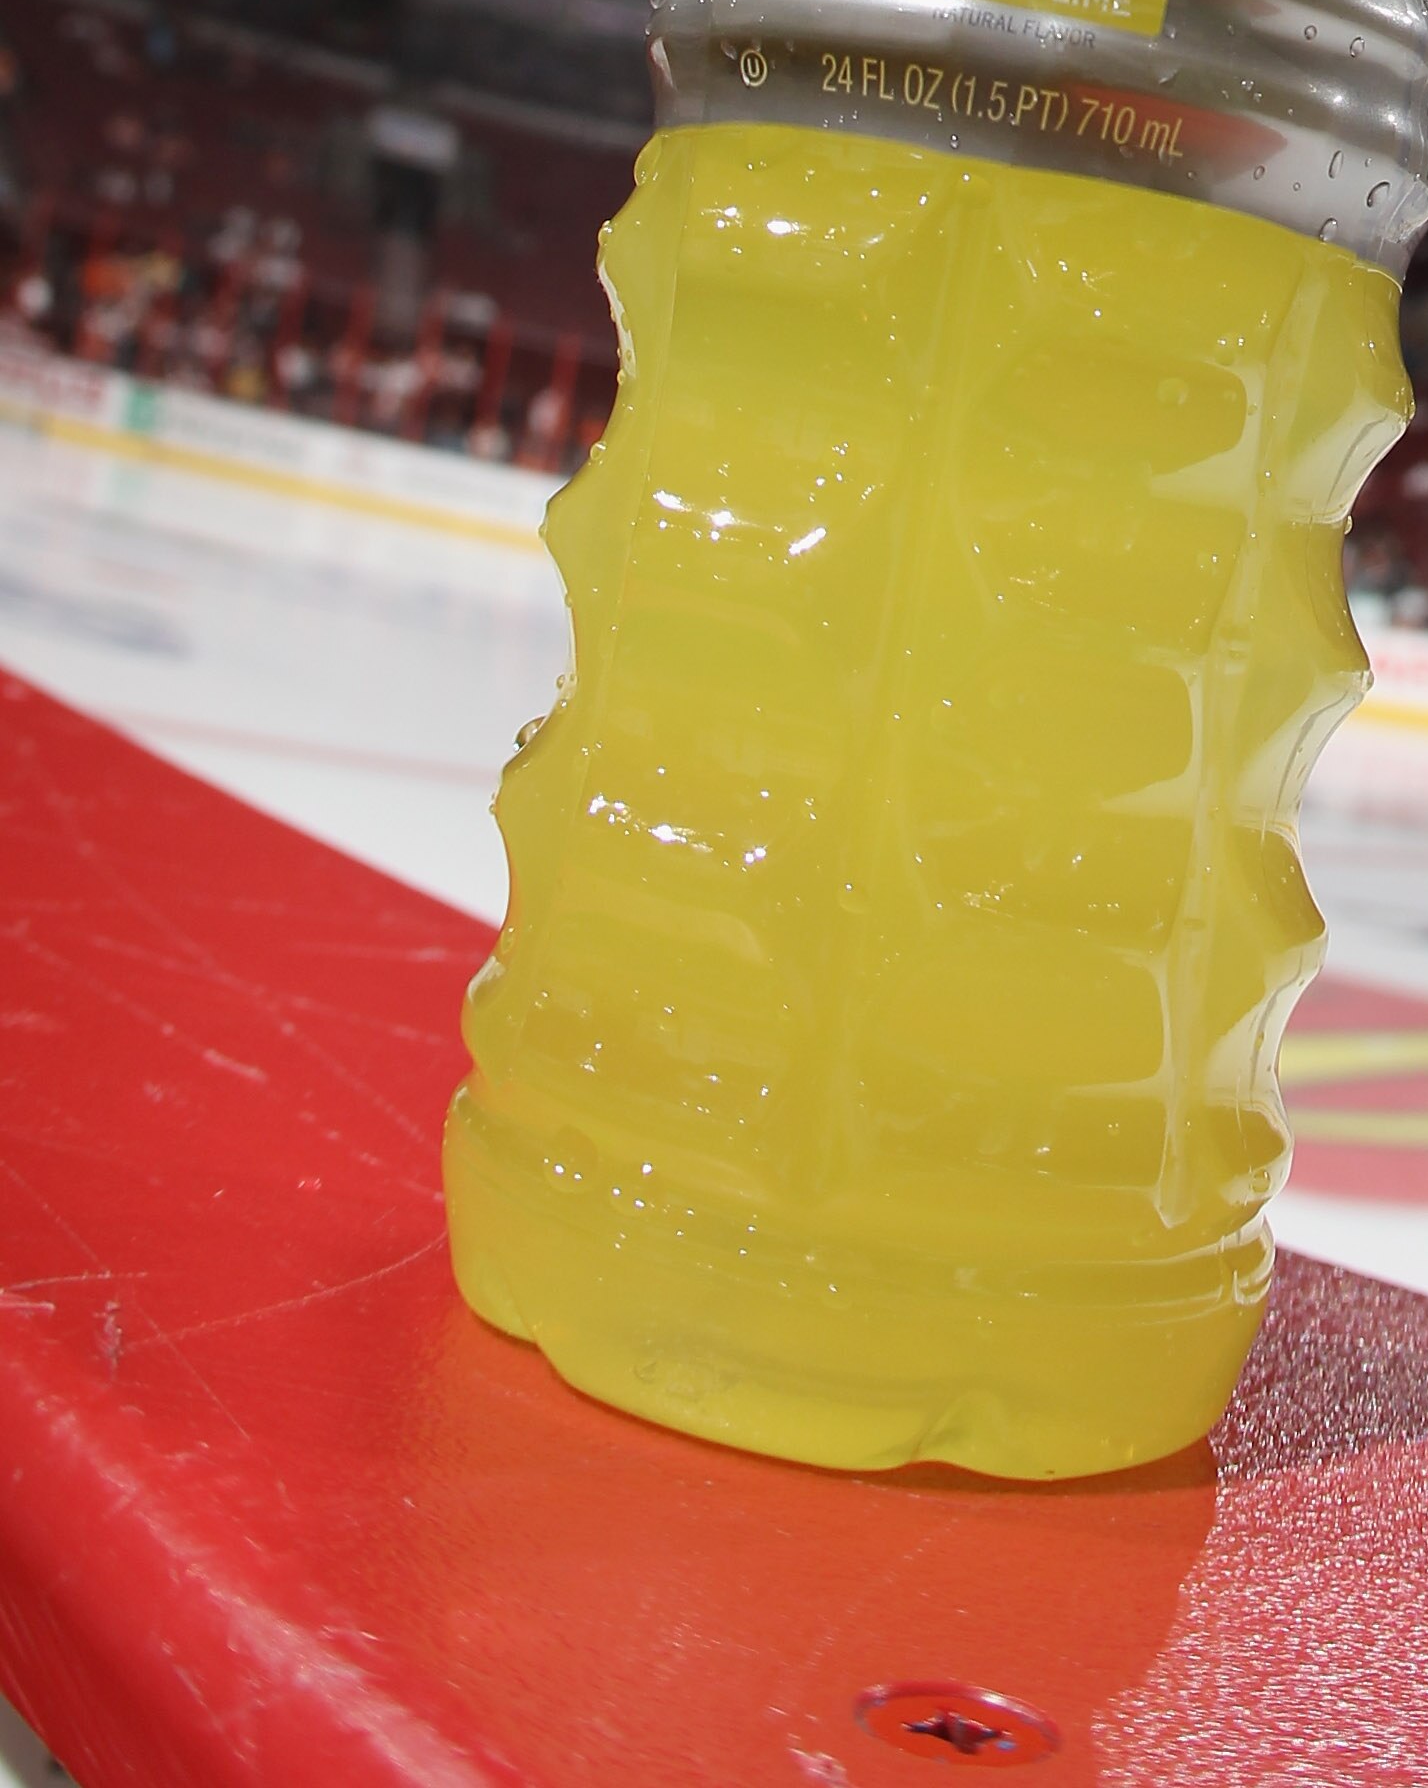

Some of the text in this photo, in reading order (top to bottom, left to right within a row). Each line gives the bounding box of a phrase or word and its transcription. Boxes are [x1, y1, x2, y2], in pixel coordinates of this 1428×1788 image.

[932, 7, 1017, 35] NATURAL
[822, 53, 854, 93] 24
[863, 58, 894, 101] FL
[904, 63, 944, 110] OZ
[1076, 98, 1136, 146] 710
[1139, 117, 1185, 160] mL
